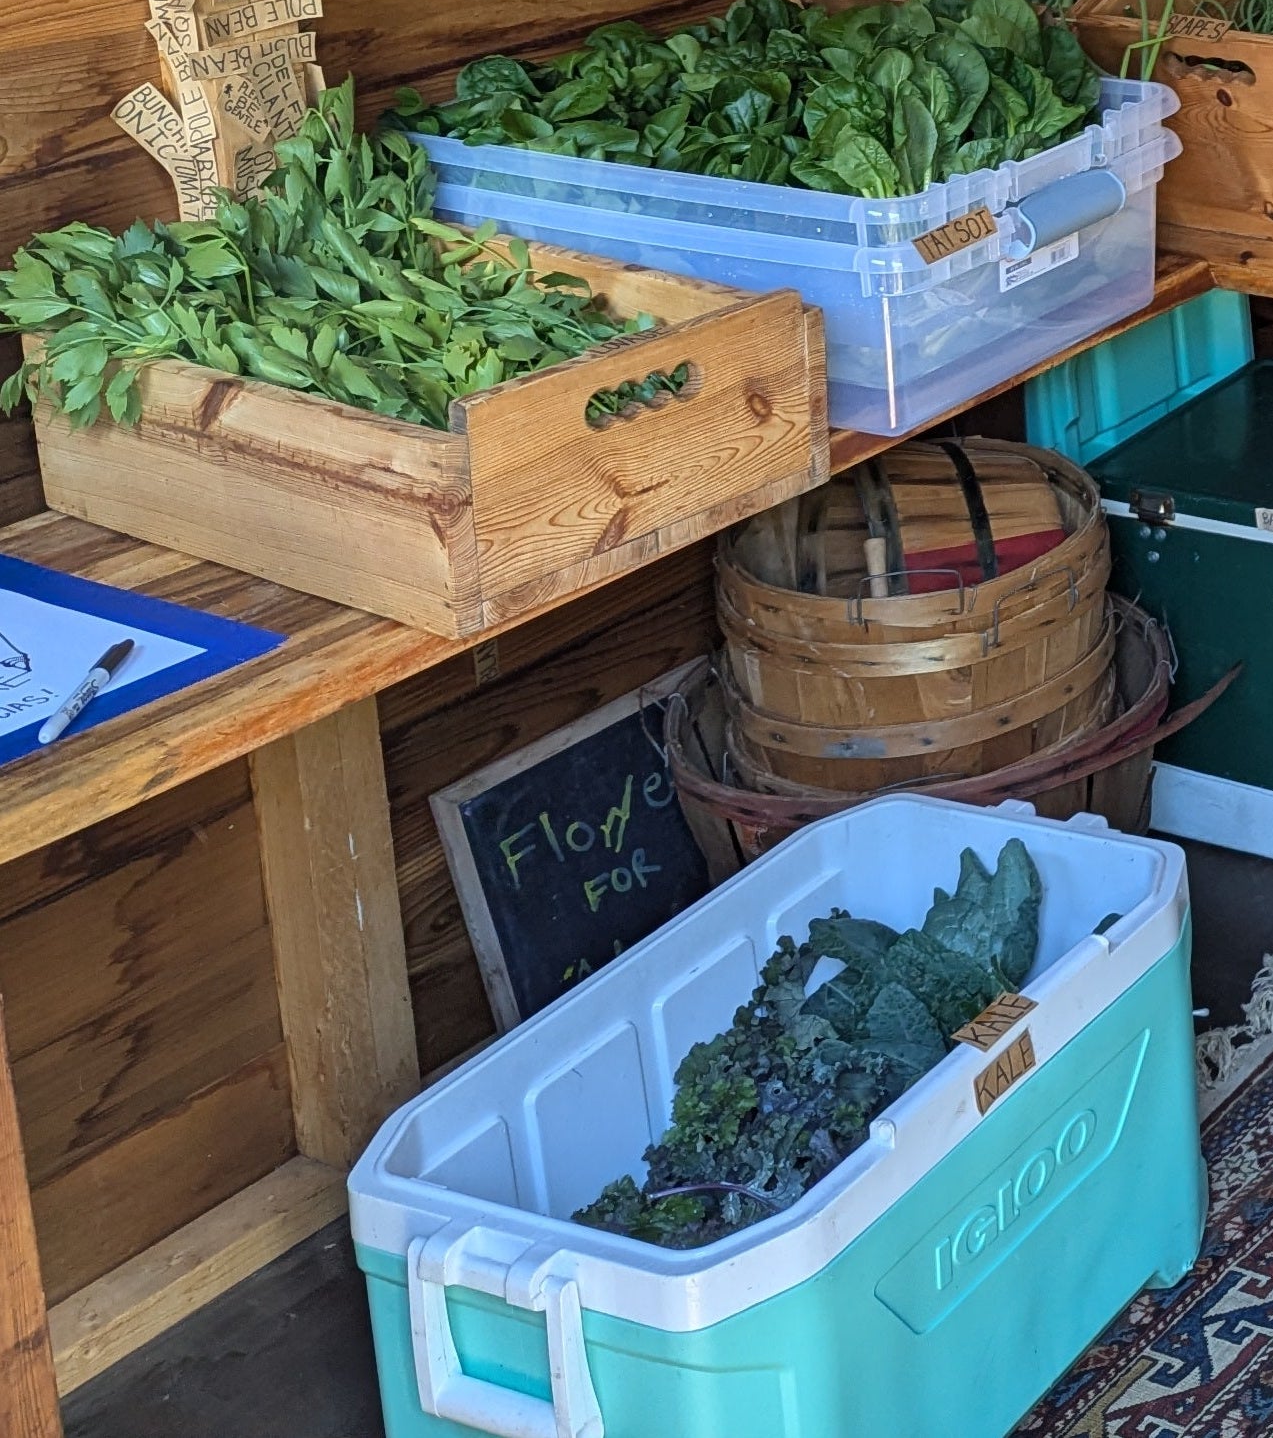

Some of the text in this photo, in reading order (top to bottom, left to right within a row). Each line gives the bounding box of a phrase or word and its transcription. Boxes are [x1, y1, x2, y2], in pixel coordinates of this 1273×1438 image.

[205, 5, 258, 42] BEAN
[191, 46, 251, 77] BEAN
[181, 87, 213, 142] POLE
[915, 209, 993, 259] TATSOI
[583, 847, 662, 912] FOR
[964, 994, 1032, 1046] KALE
[977, 1035, 1035, 1108] KALE
